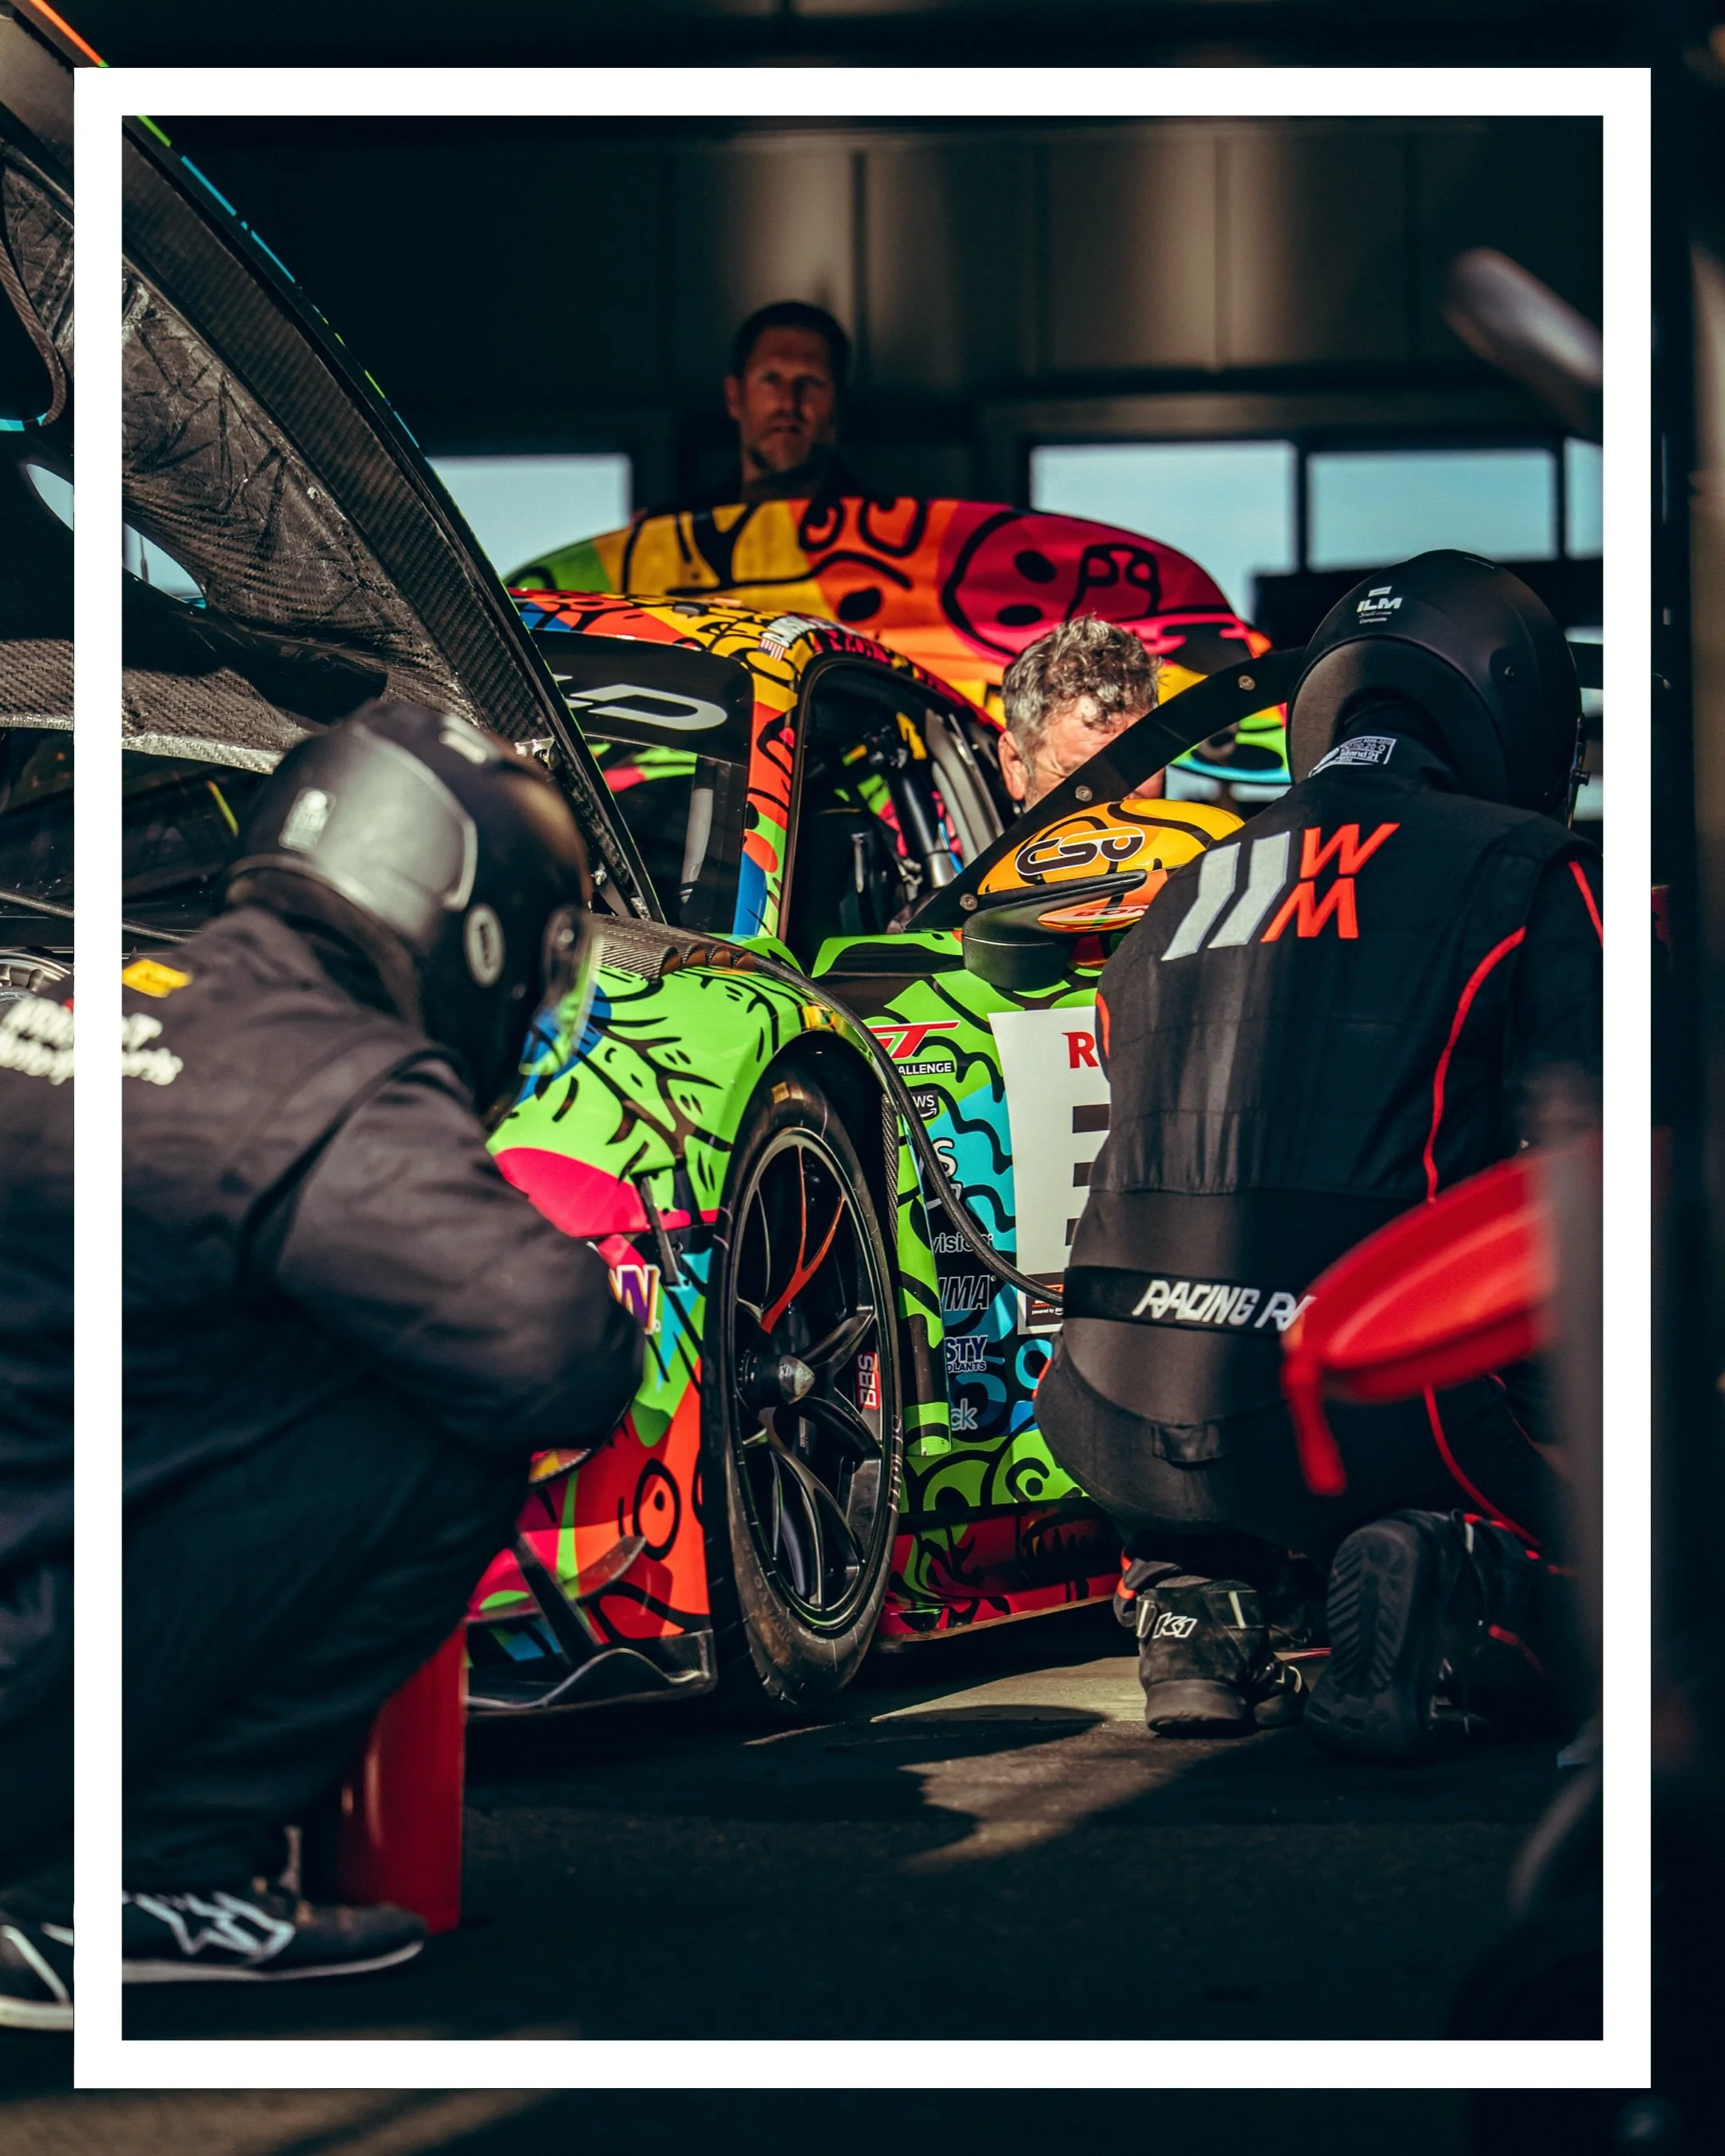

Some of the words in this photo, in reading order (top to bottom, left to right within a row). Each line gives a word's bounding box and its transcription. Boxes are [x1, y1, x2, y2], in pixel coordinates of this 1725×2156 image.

[1357, 597, 1402, 612] ILM
[552, 673, 728, 731] D
[1132, 1279, 1261, 1326] RACING
[858, 1354, 877, 1407] BBS
[1152, 1611, 1198, 1639] K1
